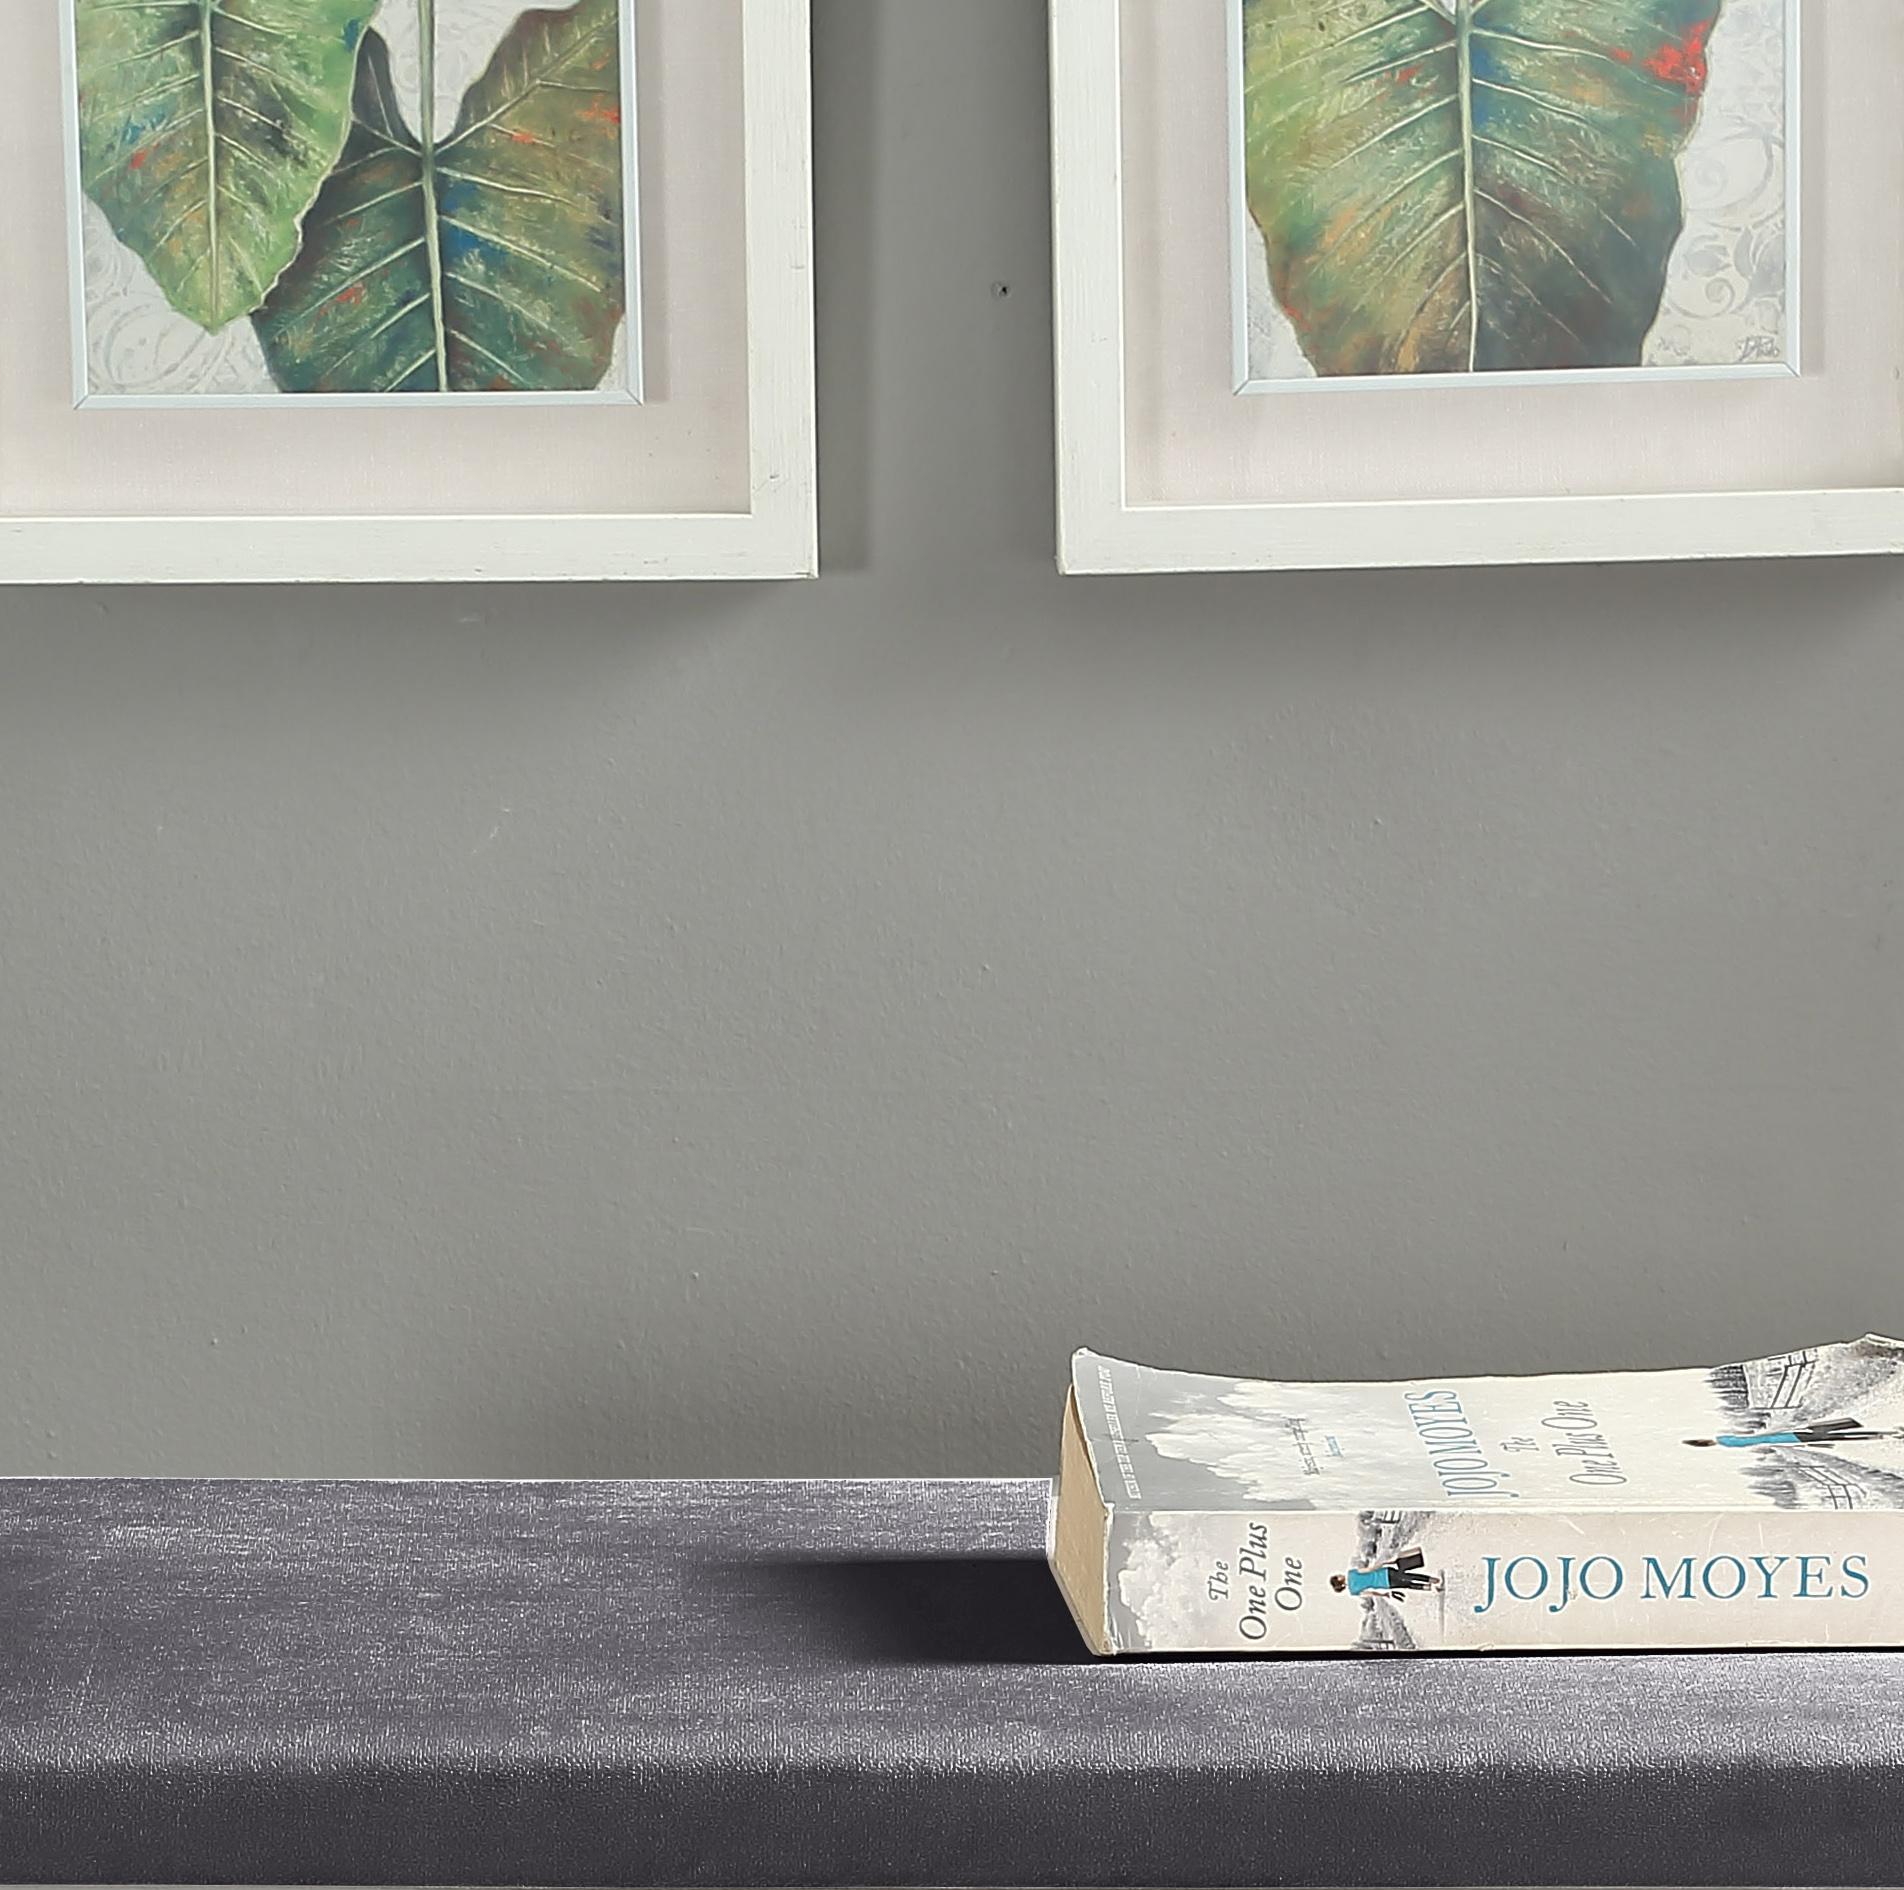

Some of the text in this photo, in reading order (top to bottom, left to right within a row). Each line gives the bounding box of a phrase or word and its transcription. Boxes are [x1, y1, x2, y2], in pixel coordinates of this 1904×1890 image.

[1403, 1390, 1520, 1498] JOJO MOYES
[1499, 1436, 1540, 1453] The
[1540, 1400, 1628, 1485] One Plus One
[1207, 1560, 1229, 1601] The
[1238, 1522, 1268, 1640] One Plus
[1274, 1556, 1303, 1612] One
[1473, 1555, 1870, 1614] JOJO MOYES
